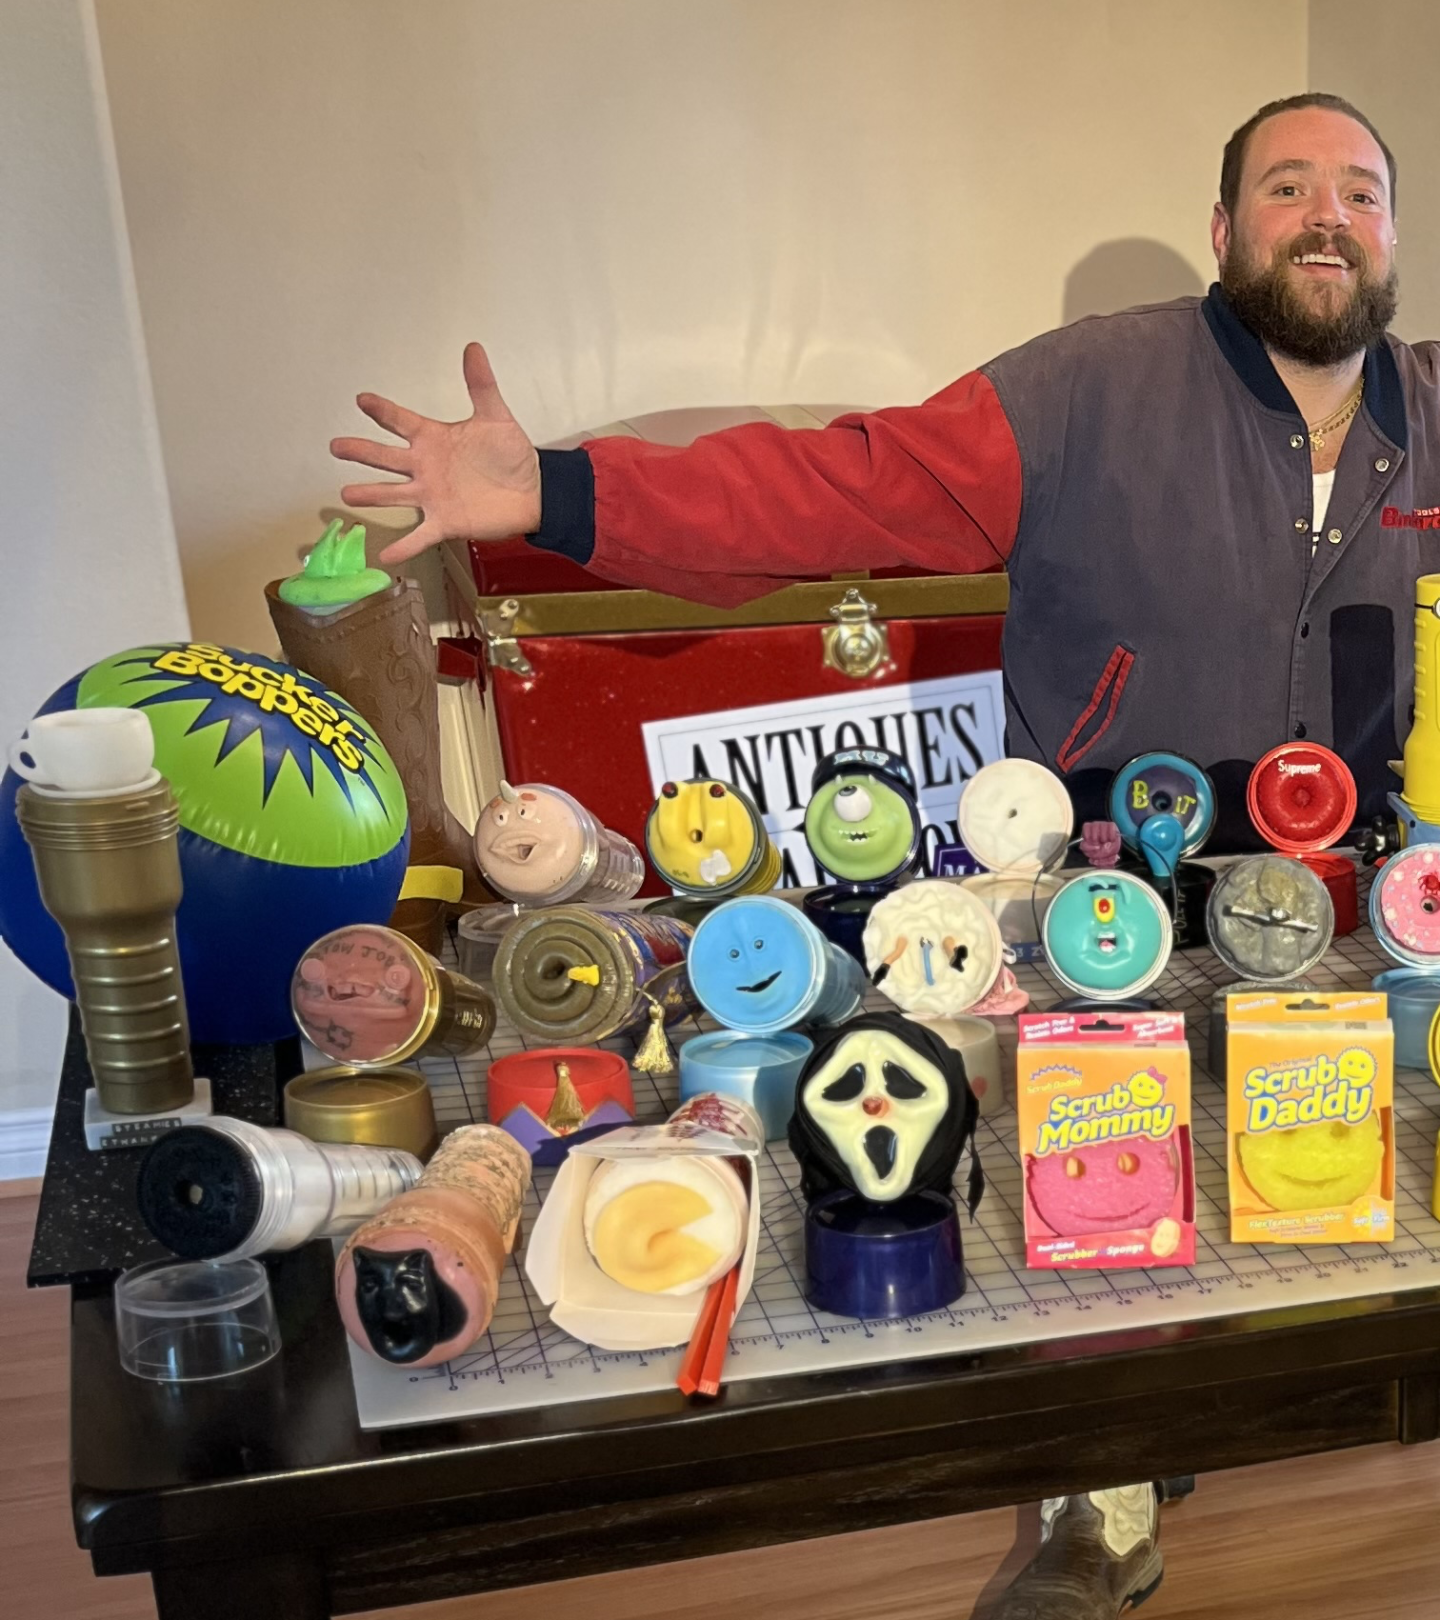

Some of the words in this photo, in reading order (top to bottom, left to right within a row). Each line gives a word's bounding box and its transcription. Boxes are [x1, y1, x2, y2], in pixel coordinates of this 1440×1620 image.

[153, 650, 364, 771] Boppers
[186, 644, 366, 743] Sucker
[1277, 759, 1322, 776] Supreme
[1132, 780, 1149, 809] B
[1173, 795, 1197, 815] IT
[1245, 1055, 1338, 1099] Scrub
[1050, 1084, 1131, 1122] Scrub
[1249, 1080, 1373, 1132] Daddy
[1037, 1105, 1175, 1154] Mommy
[1050, 1249, 1098, 1262] Scrubber
[1106, 1243, 1145, 1256] Sponge
